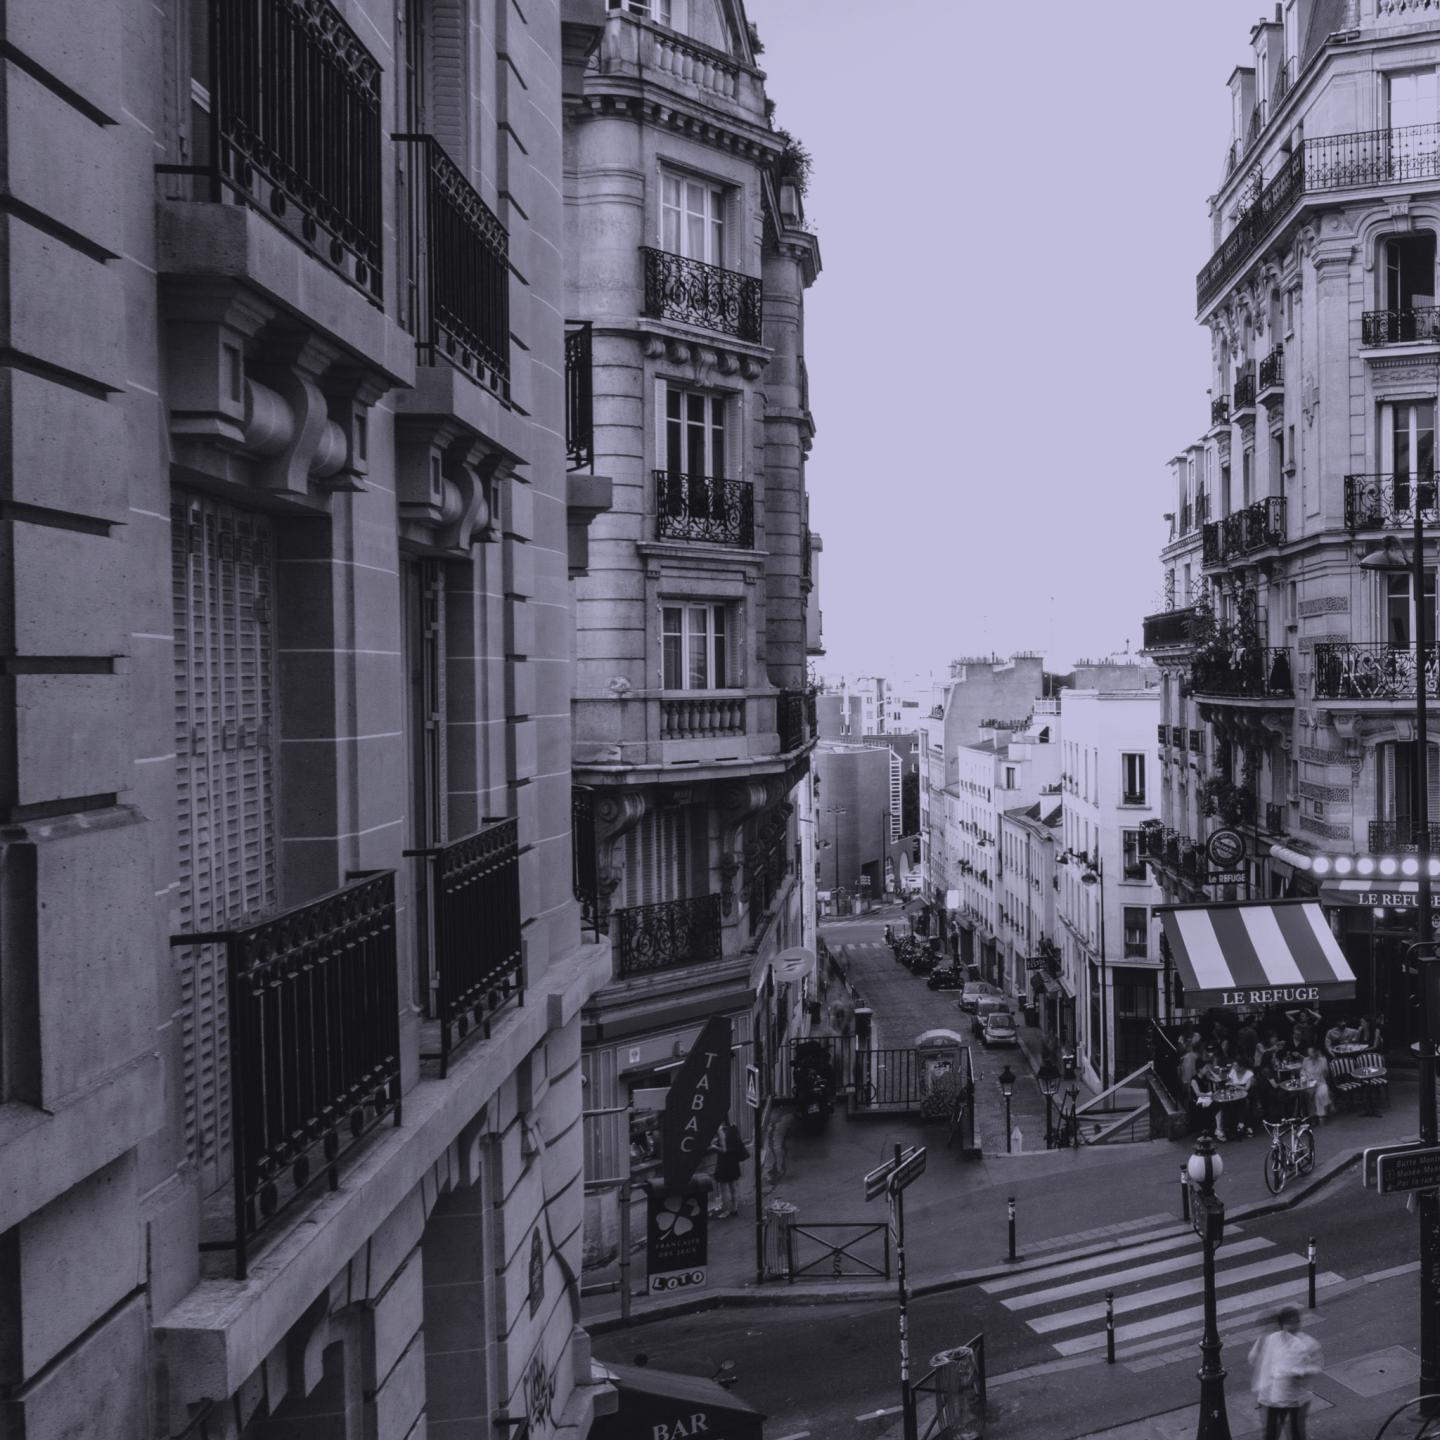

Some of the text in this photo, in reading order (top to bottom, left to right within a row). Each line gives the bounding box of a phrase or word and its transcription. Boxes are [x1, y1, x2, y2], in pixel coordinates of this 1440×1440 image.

[1358, 893, 1378, 905] LE
[1222, 987, 1320, 1006] LE REFUGE
[680, 1051, 719, 1153] TABAC
[653, 1270, 705, 1291] LOTO
[652, 1412, 709, 1440] BAR
